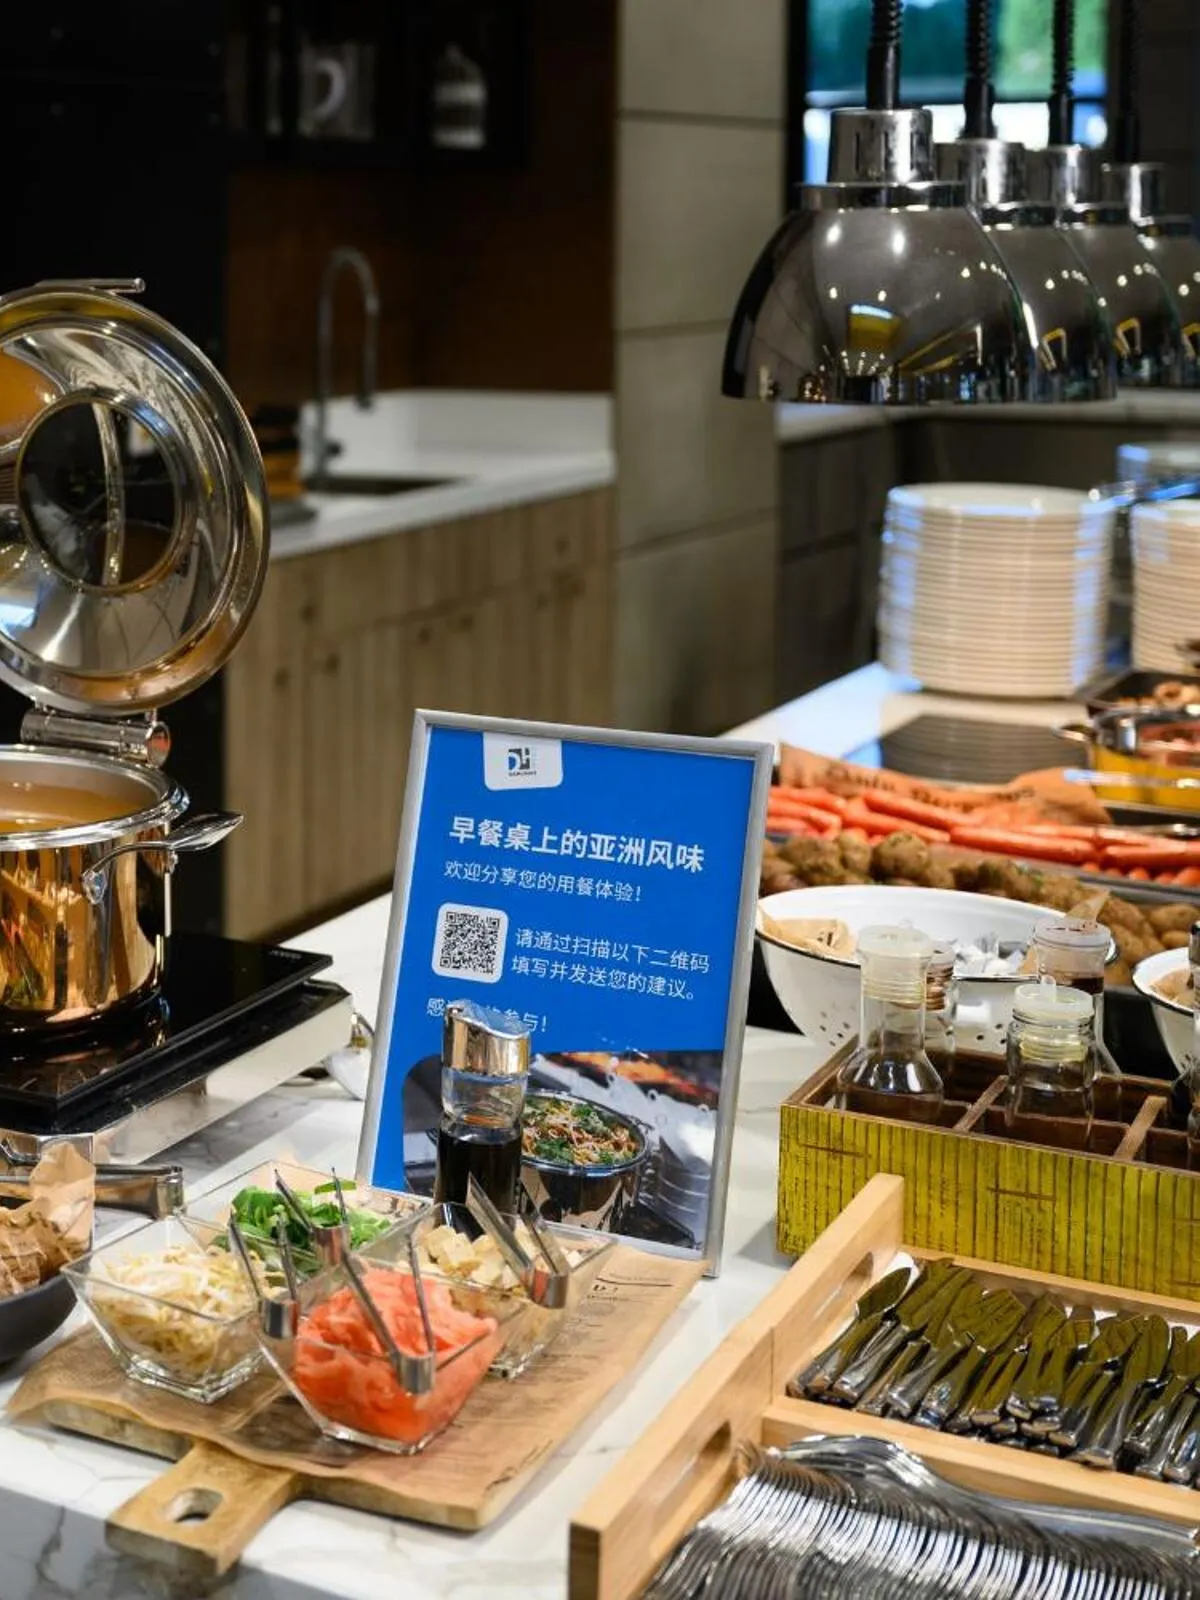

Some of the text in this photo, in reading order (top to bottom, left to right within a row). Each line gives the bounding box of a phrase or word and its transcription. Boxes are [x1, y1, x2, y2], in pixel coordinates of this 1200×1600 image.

[449, 816, 705, 873] 早餐桌上的亚洲风味
[444, 860, 642, 902] 欢迎分享您的用餐体验！
[515, 928, 710, 973] 请通过扫描以下二维码
[511, 955, 694, 1000] 填写并发送您的建议。
